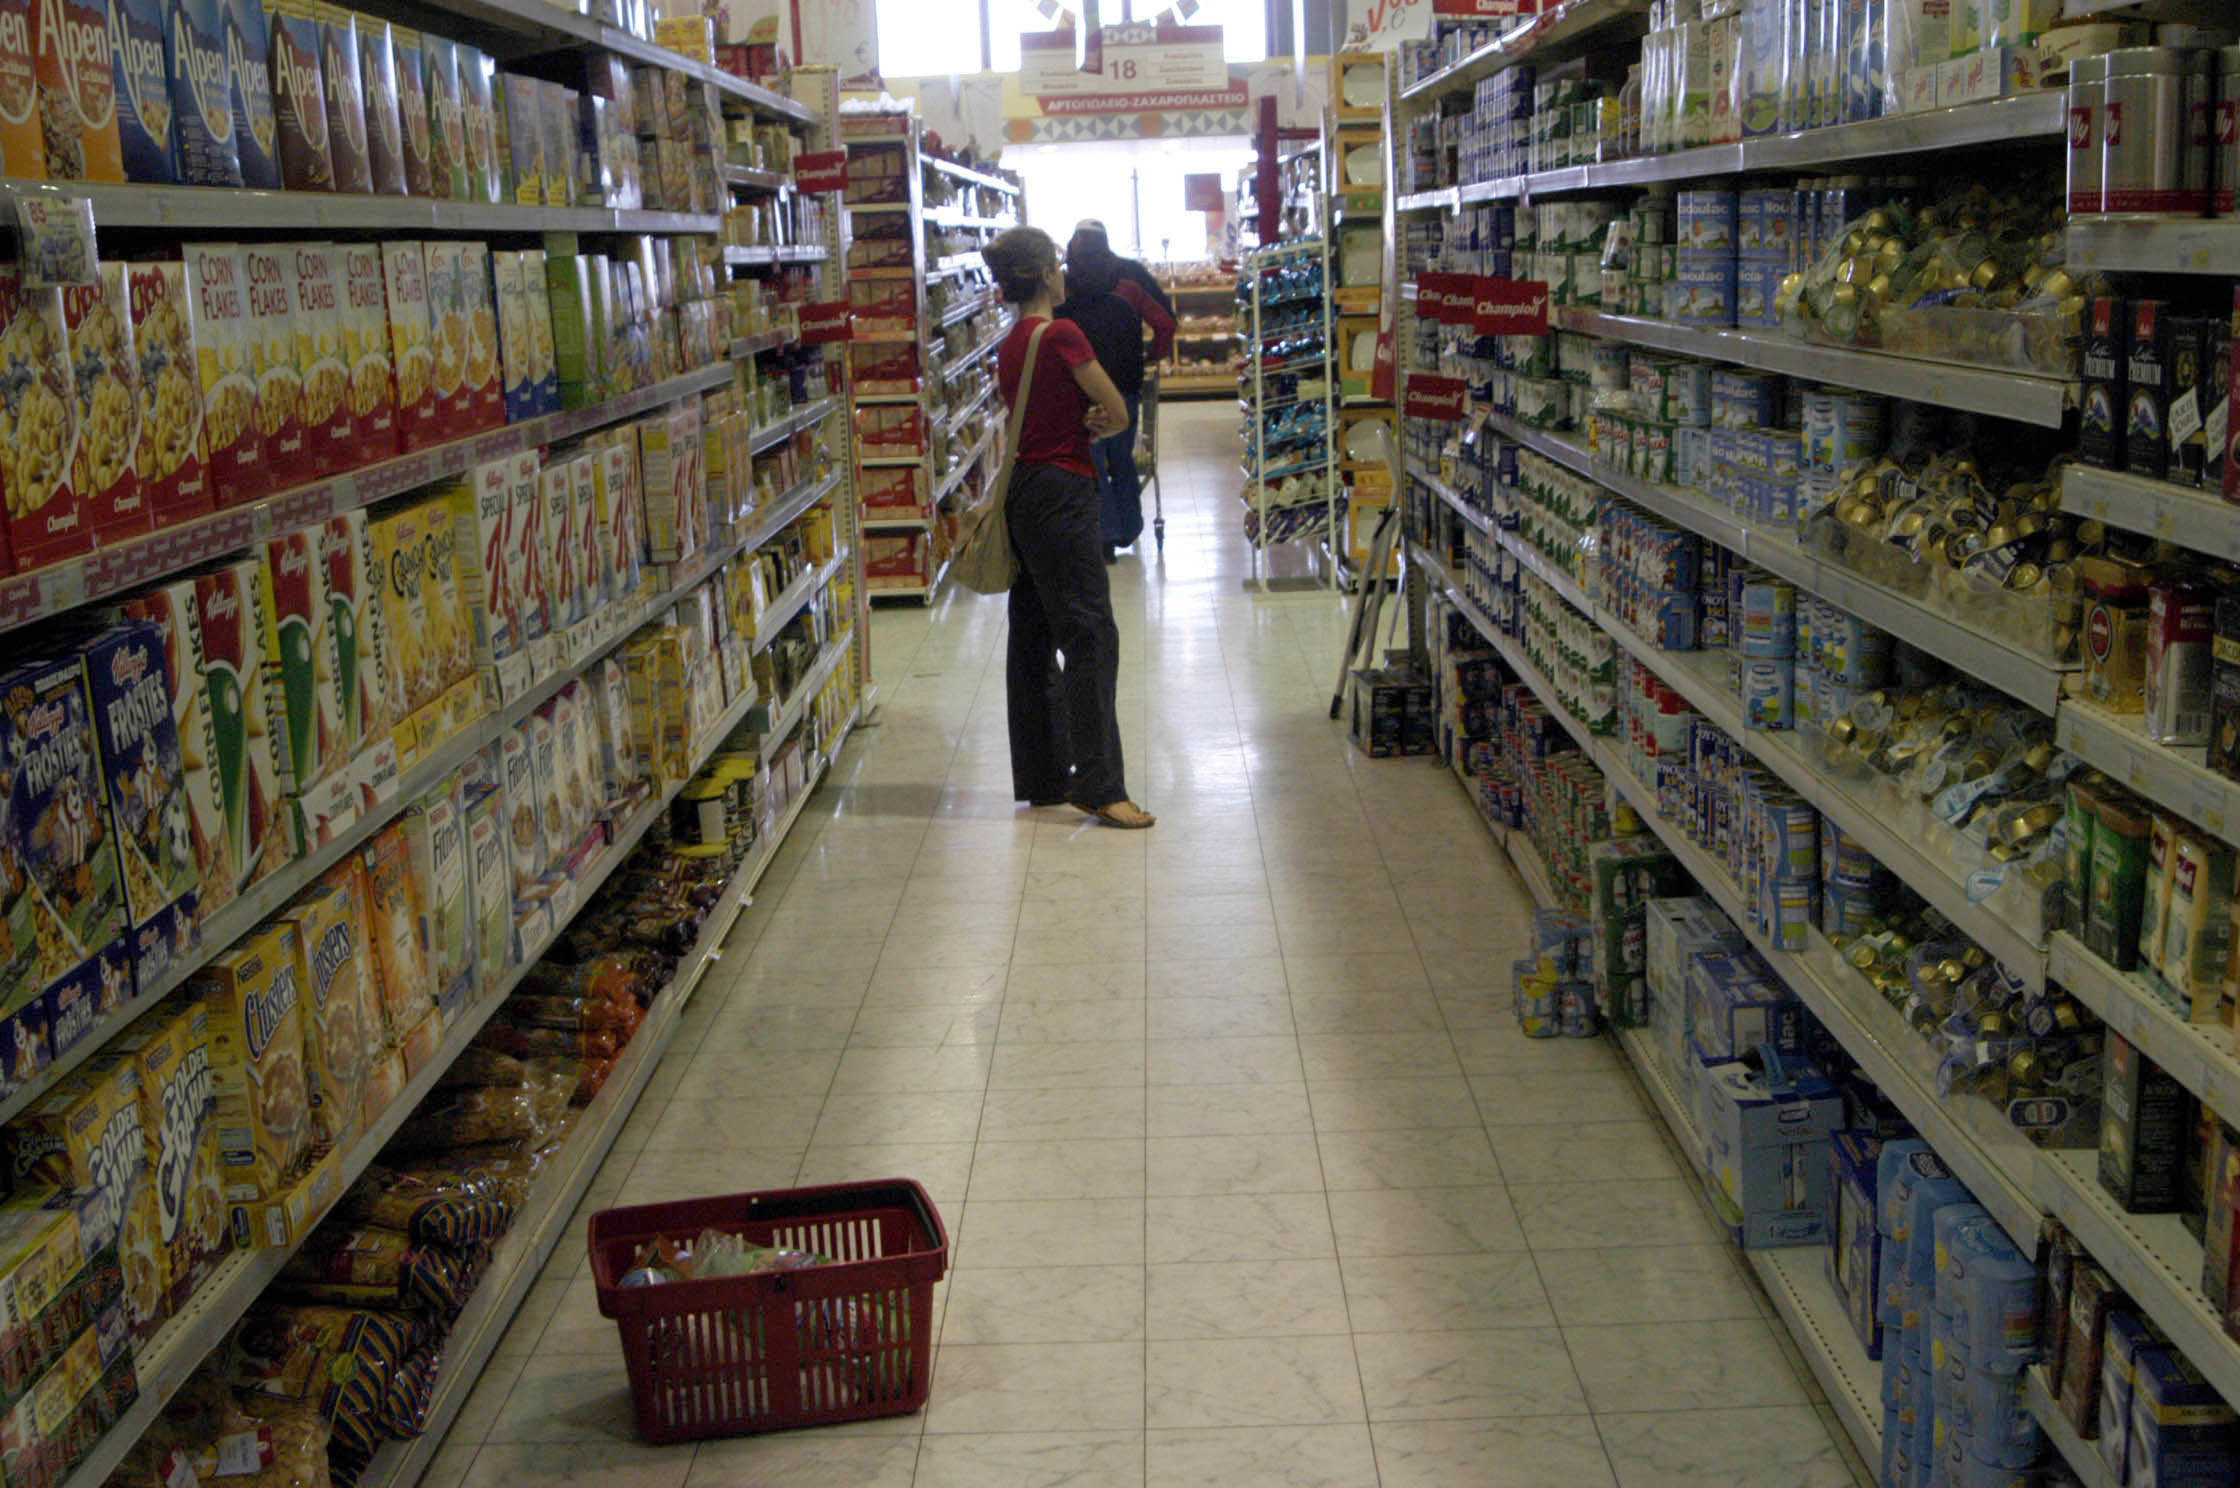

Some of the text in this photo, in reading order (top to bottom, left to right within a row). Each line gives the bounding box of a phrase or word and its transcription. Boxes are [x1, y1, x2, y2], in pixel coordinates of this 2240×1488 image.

[38, 0, 112, 85] Alpen
[1109, 59, 1137, 80] 18
[199, 251, 233, 286] CORN
[248, 252, 282, 285] CORN
[201, 287, 240, 321] FLAKES
[249, 285, 288, 318] FLAKES
[298, 281, 335, 312] FLAKES
[1476, 299, 1542, 319] Champion
[107, 669, 169, 755] FROSTIES
[24, 724, 82, 800] FROSTIES
[202, 720, 224, 812] CORN
